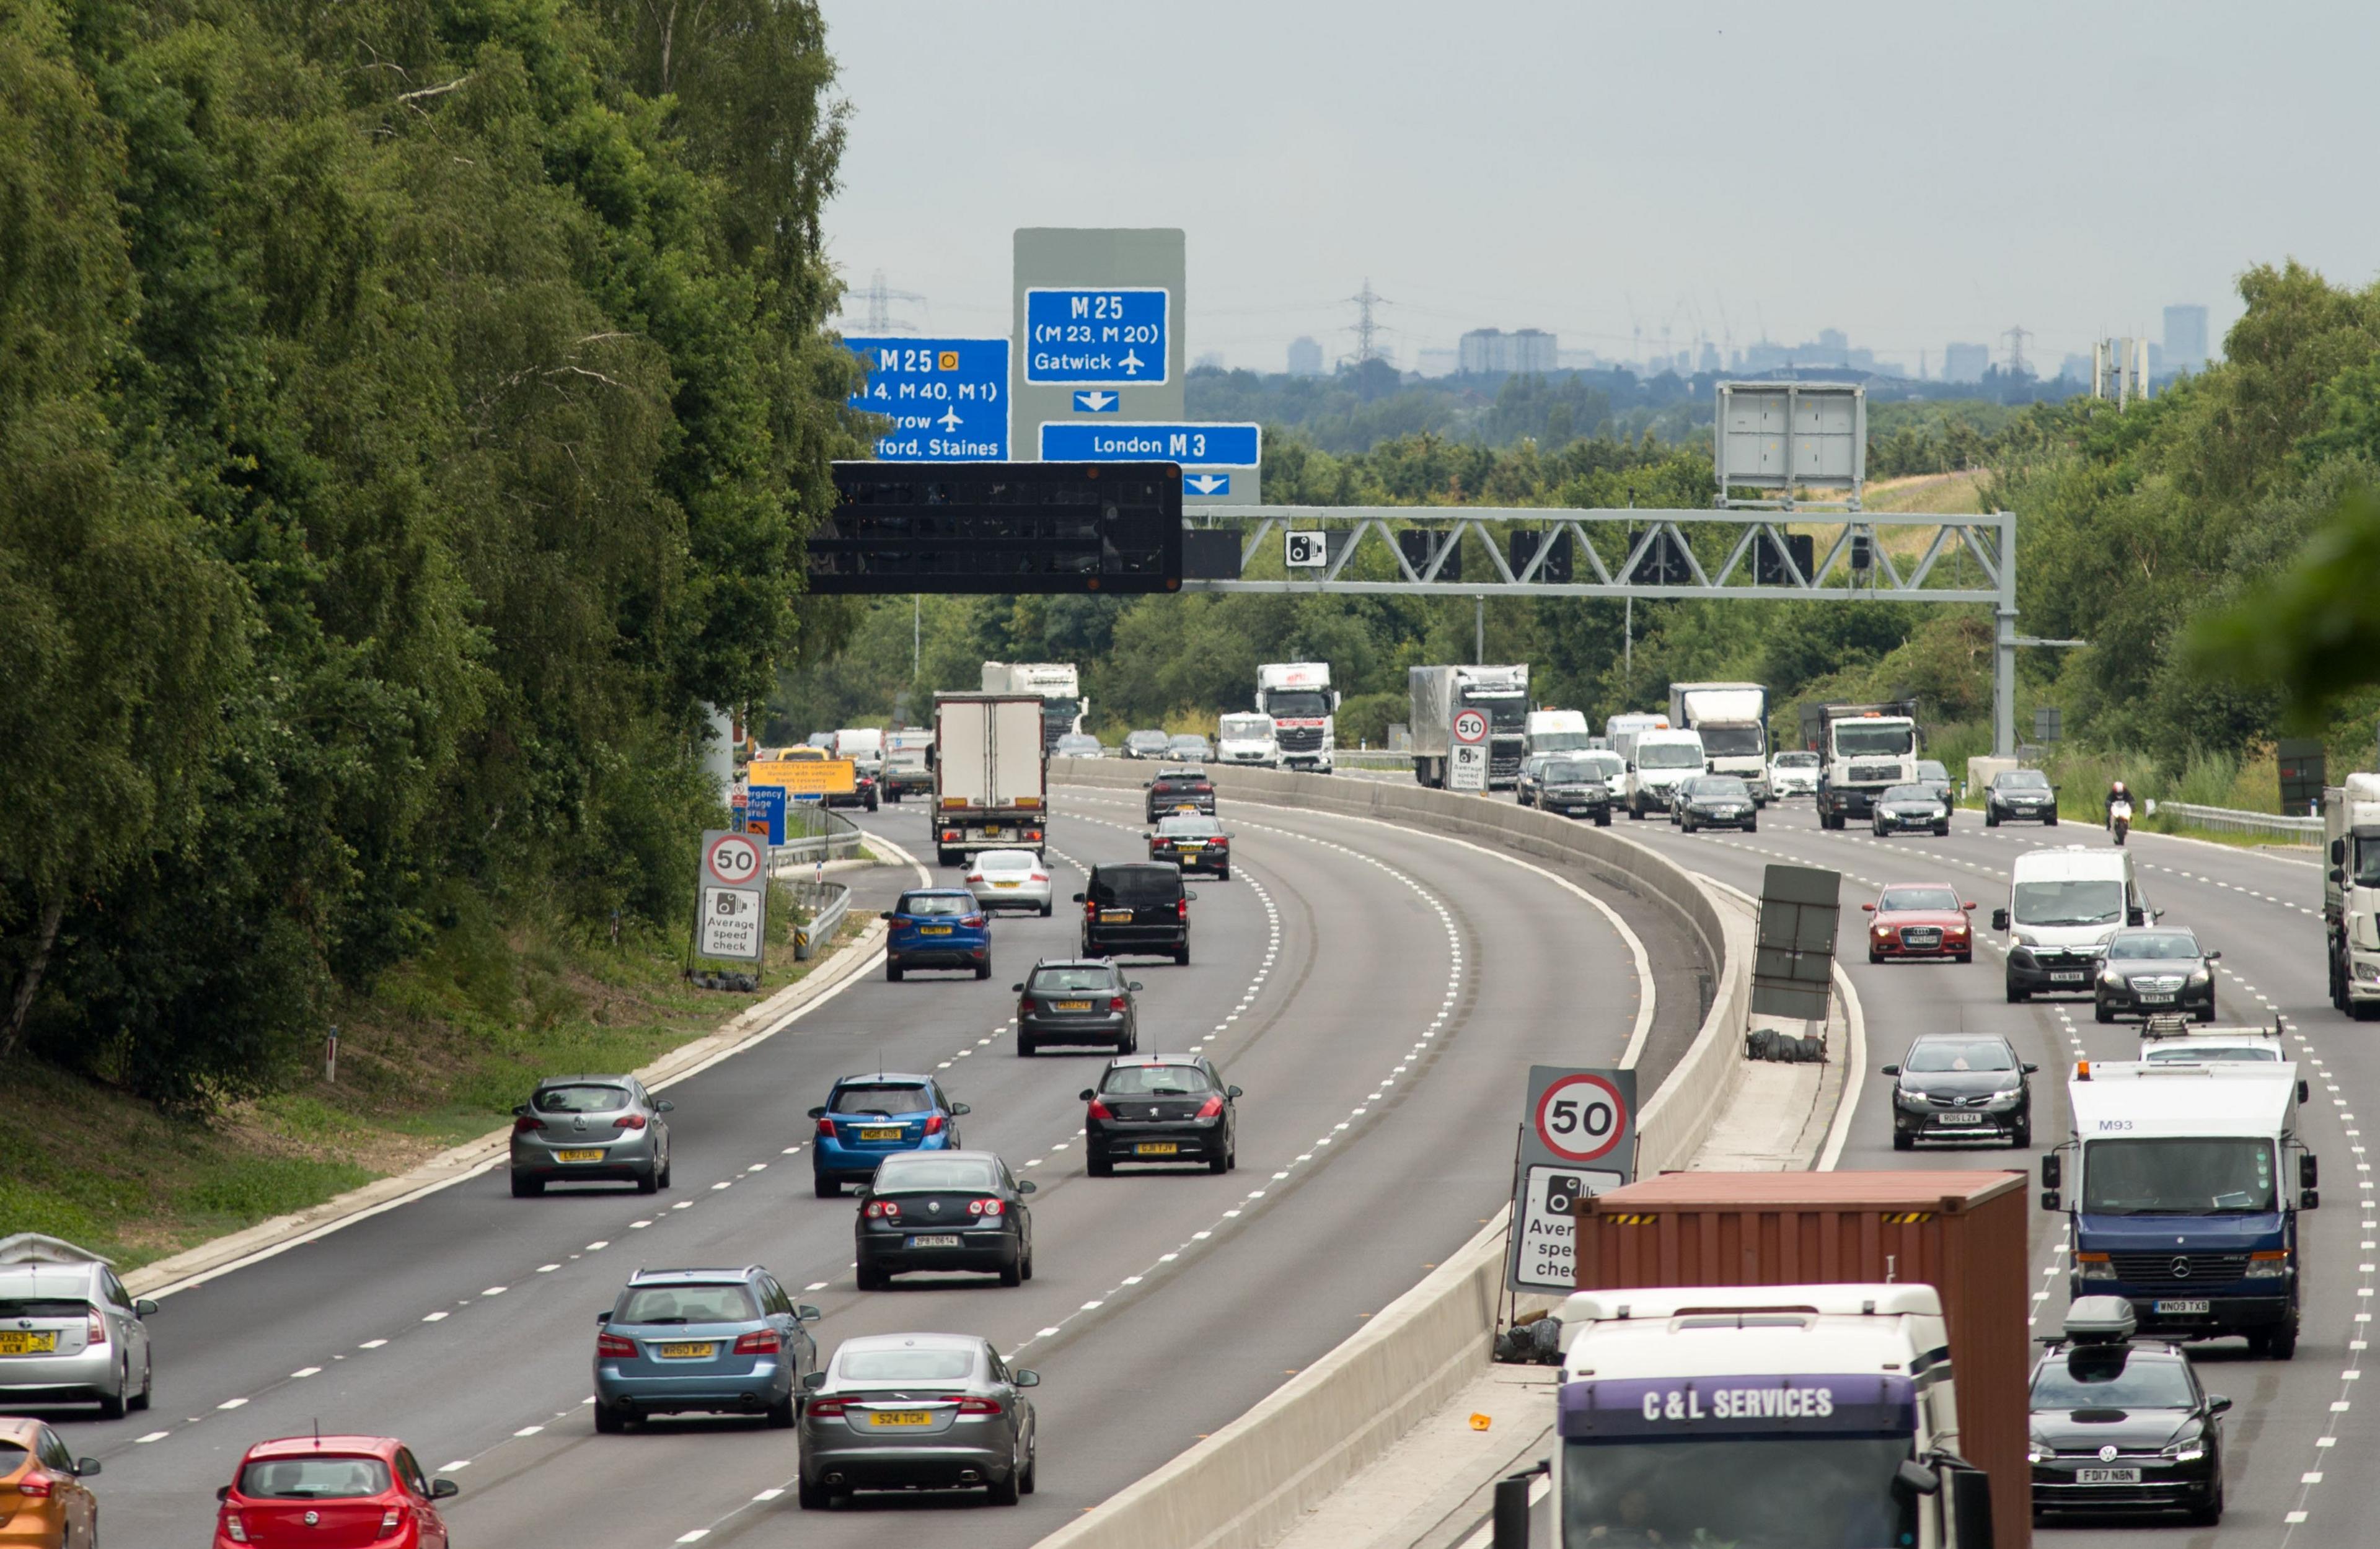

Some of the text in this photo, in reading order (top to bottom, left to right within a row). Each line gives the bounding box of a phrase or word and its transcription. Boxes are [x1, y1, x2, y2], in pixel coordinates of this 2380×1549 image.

[1034, 352, 1111, 370] Gatwick
[929, 439, 998, 456] Staines
[1094, 436, 1162, 454] London
[1459, 720, 1482, 734] 50
[717, 849, 752, 871] 50
[707, 917, 754, 929] Average
[713, 930, 747, 940] speed
[713, 941, 746, 951] check
[1551, 1100, 1613, 1136] 50
[2099, 1120, 2133, 1131] M93
[583, 1151, 597, 1159] UXL
[1538, 1243, 1576, 1258] spe
[2160, 1301, 2208, 1311] WN09 TXB
[0, 1333, 25, 1342] RX63
[2, 1343, 22, 1353] XCW
[663, 1343, 712, 1354] WR60 WPJ
[1712, 1387, 1833, 1418] SERVICES
[879, 1413, 923, 1424] S24 TCH
[2084, 1470, 2133, 1481] FD17 NBN
